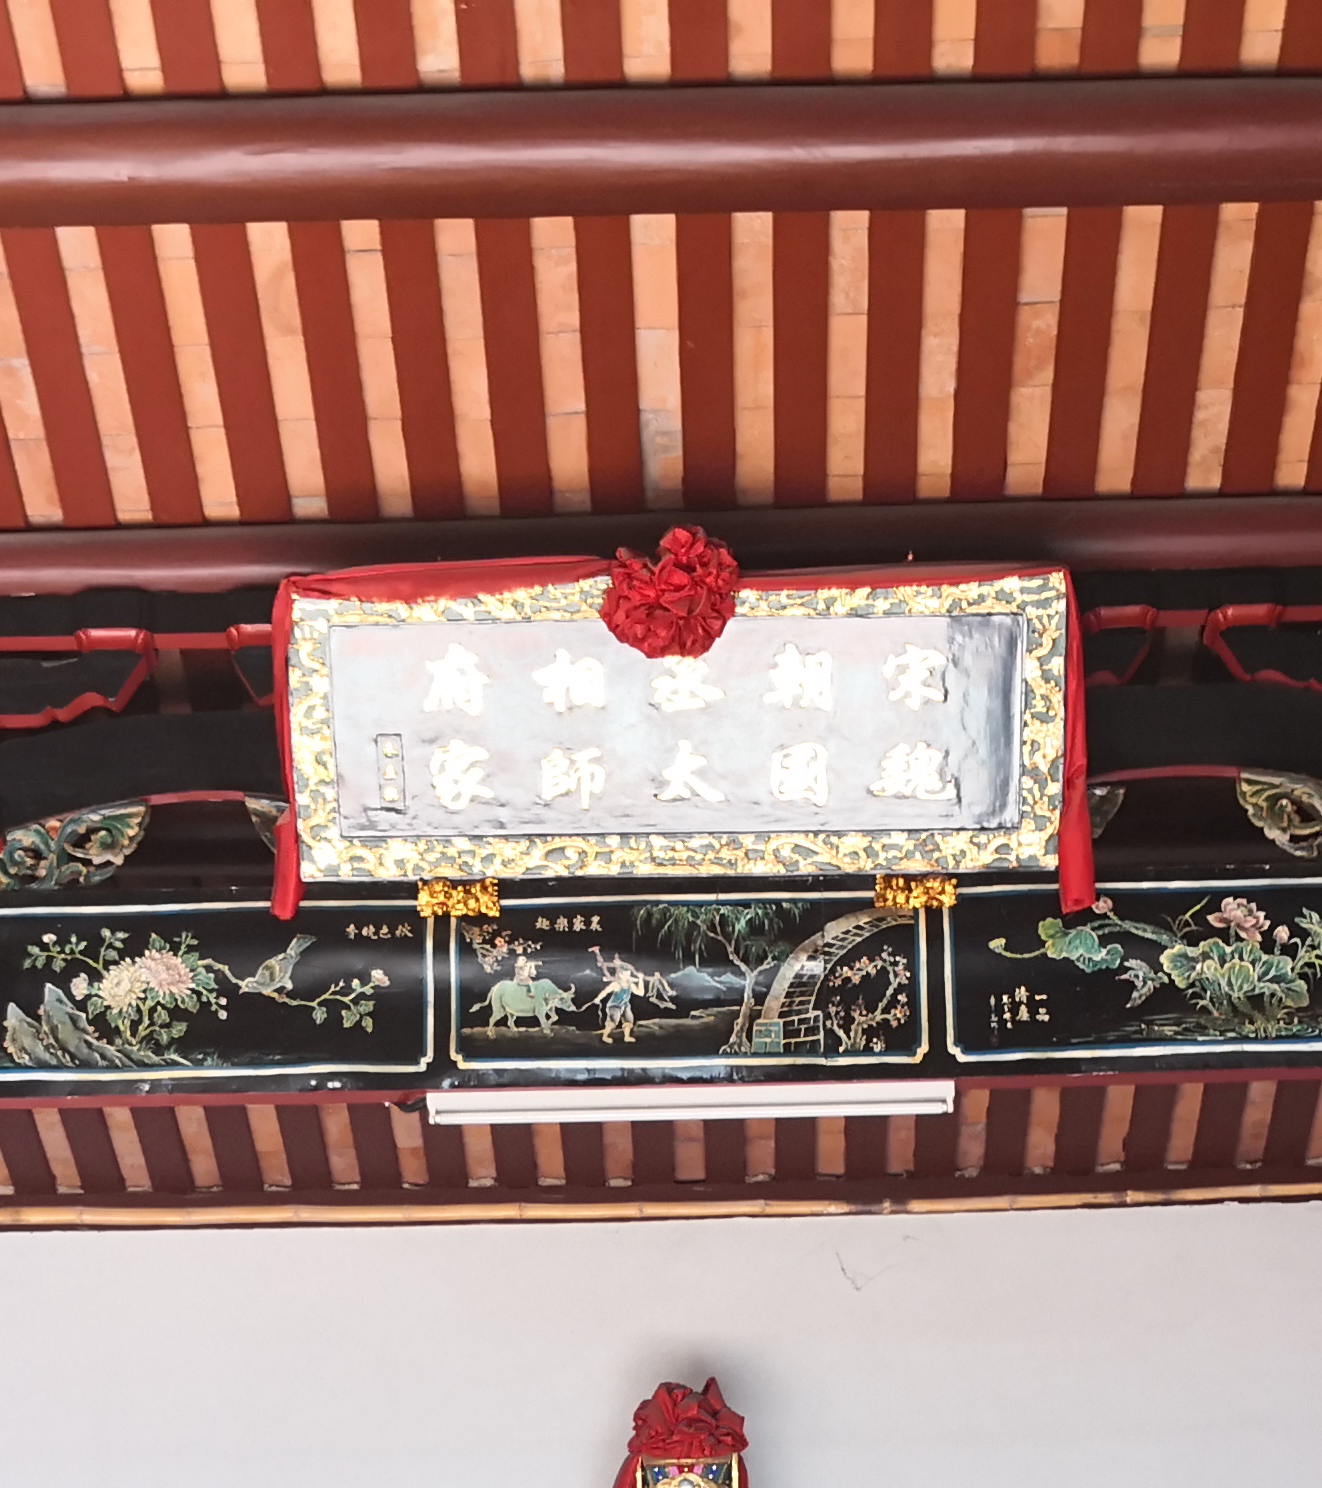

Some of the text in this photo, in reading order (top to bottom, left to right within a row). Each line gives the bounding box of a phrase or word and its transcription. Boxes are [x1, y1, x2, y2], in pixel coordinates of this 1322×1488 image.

[422, 642, 948, 717] 宋朝丞相府
[429, 738, 958, 811] 魏國太師家
